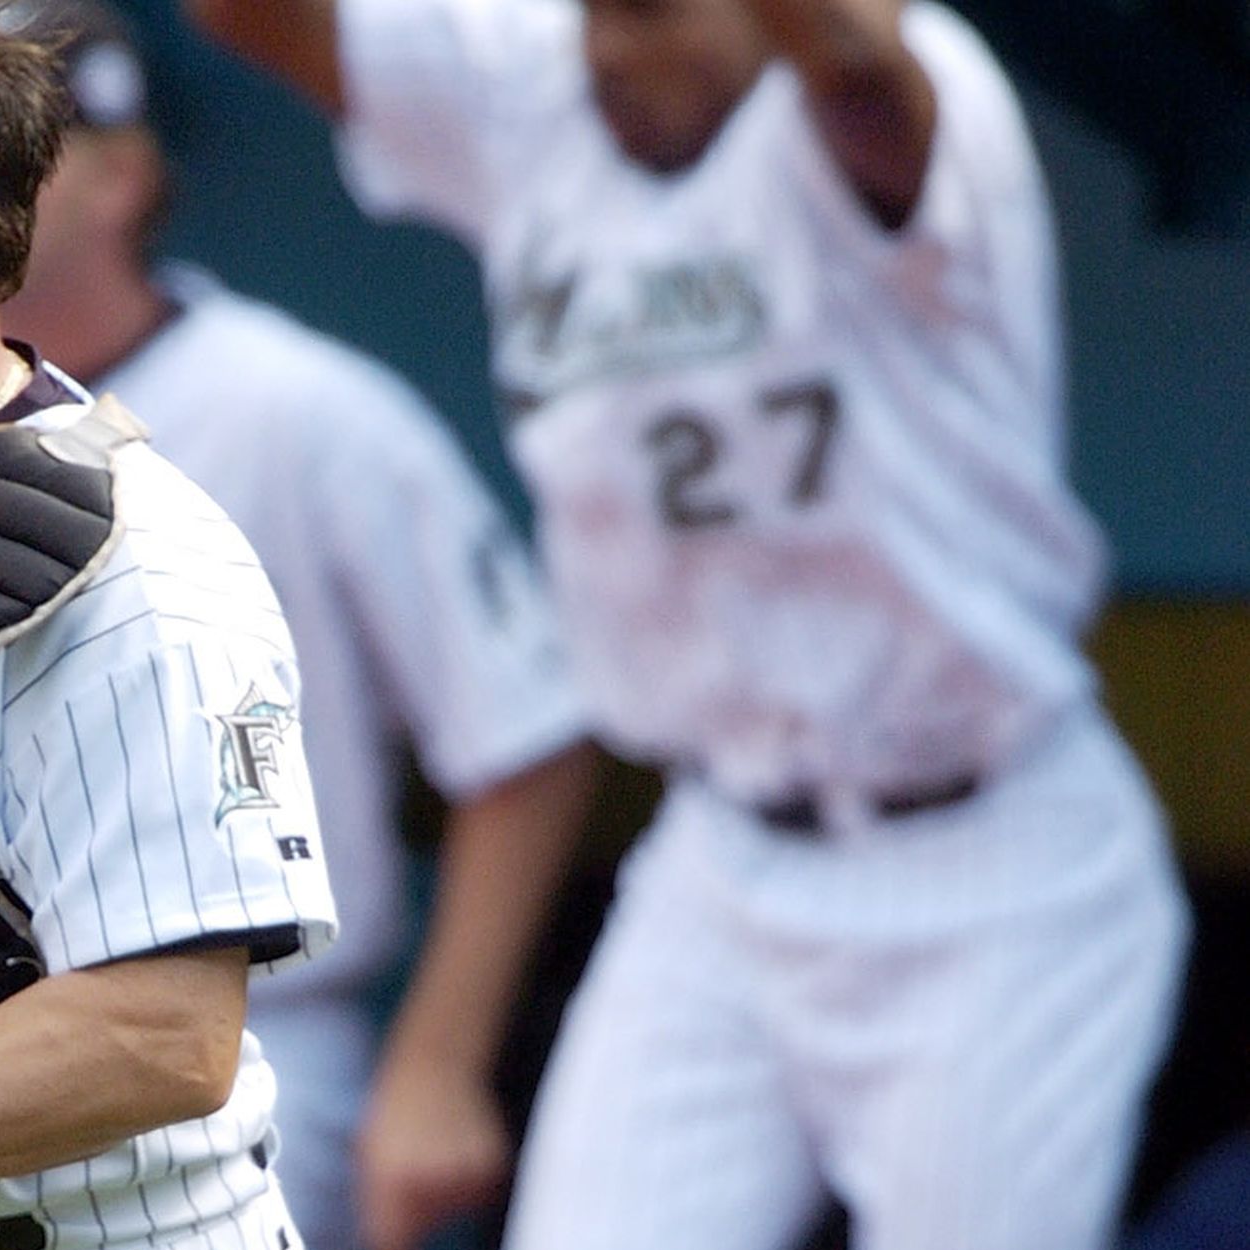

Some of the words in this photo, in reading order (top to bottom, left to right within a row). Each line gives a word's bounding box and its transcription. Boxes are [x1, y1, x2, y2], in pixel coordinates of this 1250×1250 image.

[642, 374, 845, 531] 27
[214, 713, 285, 810] F
[277, 836, 313, 861] R
